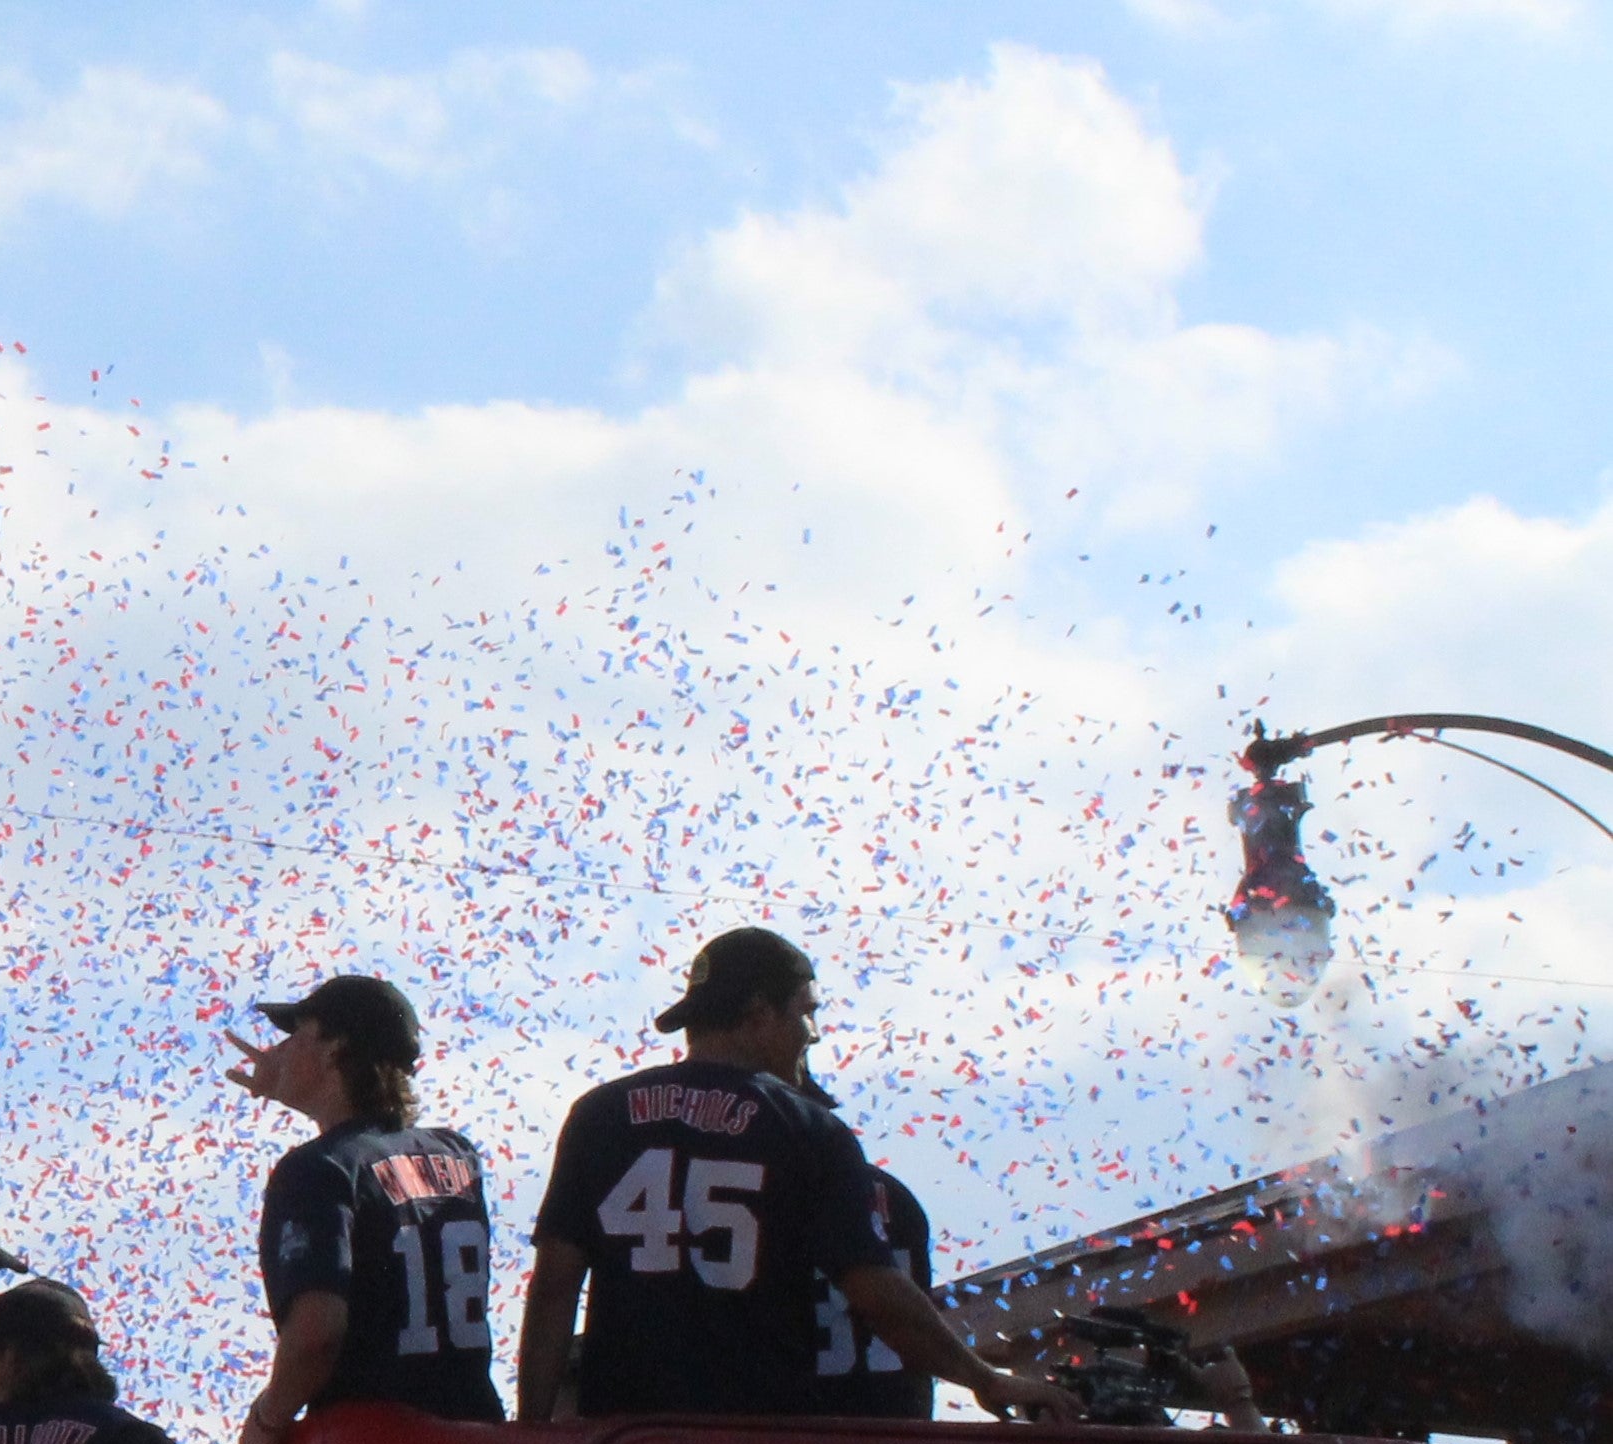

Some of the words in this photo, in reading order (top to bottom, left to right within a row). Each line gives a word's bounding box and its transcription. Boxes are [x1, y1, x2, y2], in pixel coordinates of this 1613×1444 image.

[627, 1083, 759, 1135] NICHOLS
[596, 1147, 766, 1291] 45
[392, 1220, 491, 1356] 18
